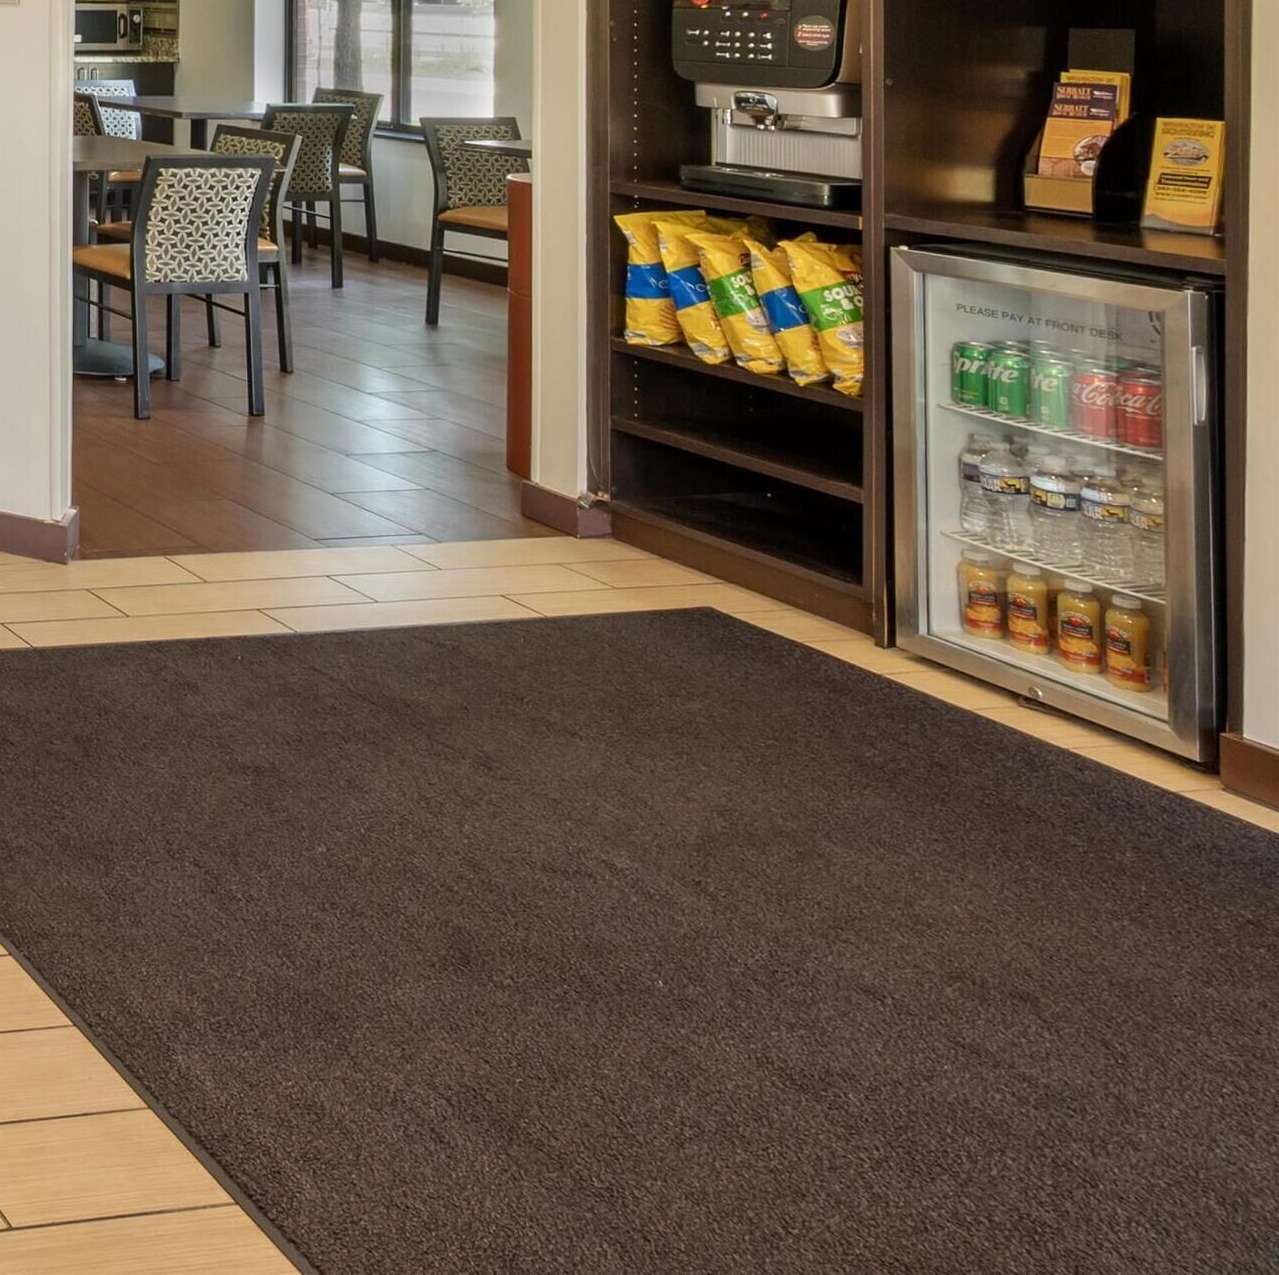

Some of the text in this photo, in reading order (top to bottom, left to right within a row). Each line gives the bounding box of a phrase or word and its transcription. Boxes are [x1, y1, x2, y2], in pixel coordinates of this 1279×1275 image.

[956, 303, 1124, 342] PLEASE PAY AT FRONT DESK
